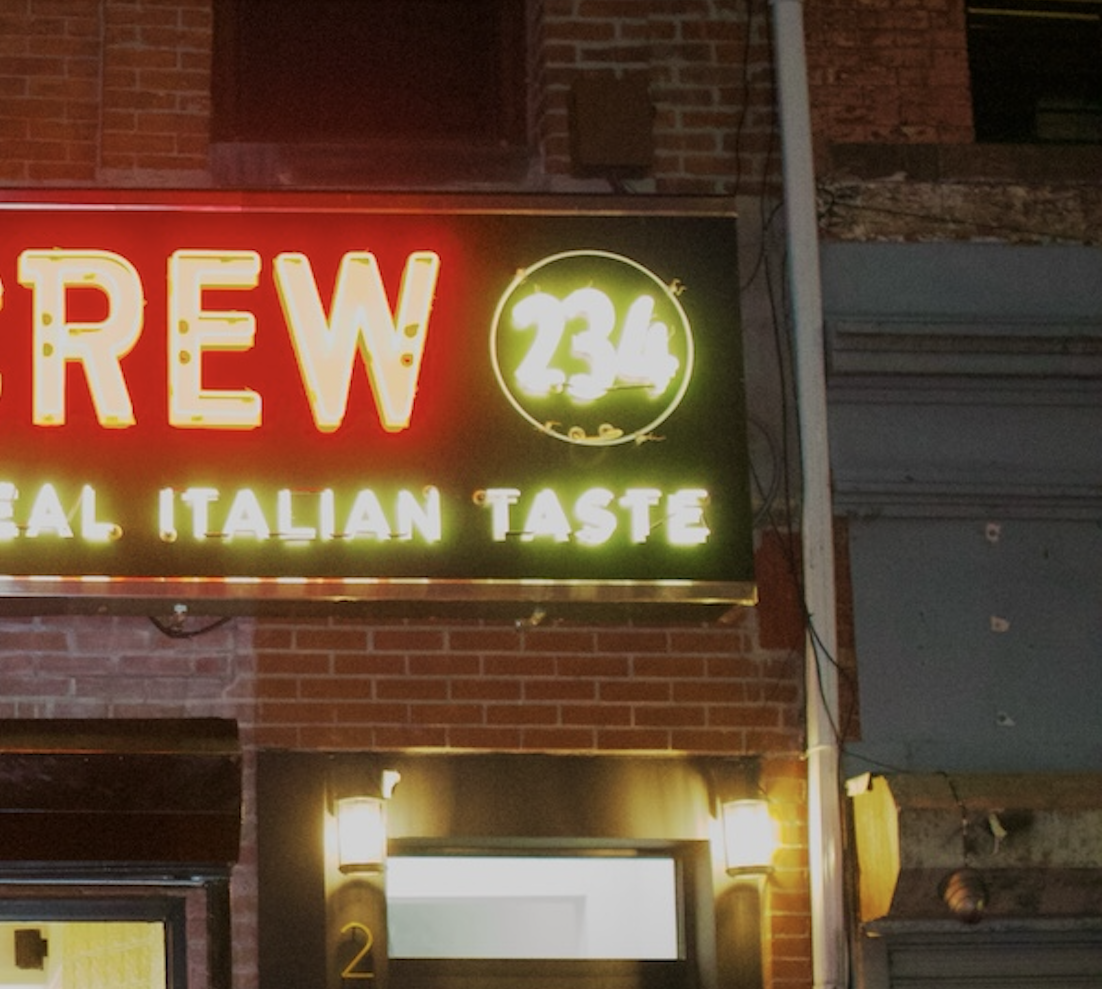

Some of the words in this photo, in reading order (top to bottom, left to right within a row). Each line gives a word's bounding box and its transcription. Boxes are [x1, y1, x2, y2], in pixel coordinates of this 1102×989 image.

[511, 287, 680, 405] 234
[159, 486, 443, 542] ITALIAN
[484, 487, 712, 545] TASTE
